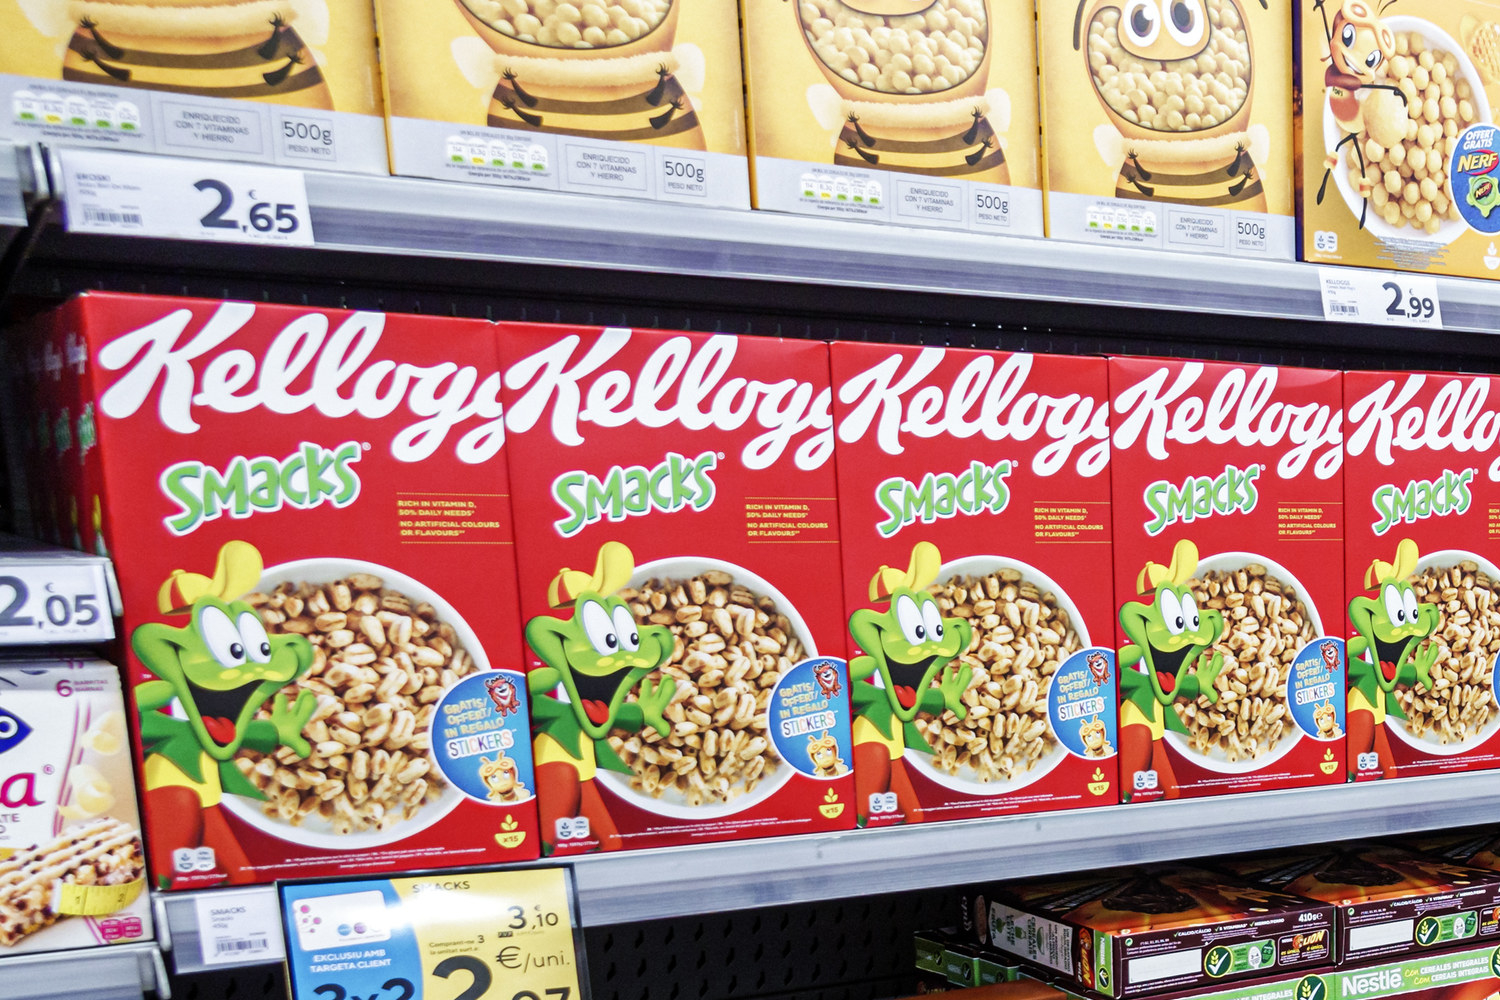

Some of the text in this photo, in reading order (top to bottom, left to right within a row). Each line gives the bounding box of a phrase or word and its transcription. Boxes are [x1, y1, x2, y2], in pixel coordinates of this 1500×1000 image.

[283, 121, 333, 146] 500g
[1463, 138, 1493, 150] GRATIS
[1466, 129, 1496, 140] OFFERT
[665, 160, 705, 183] 500g
[1457, 152, 1500, 173] NERF
[1382, 281, 1435, 319] 2,99
[449, 731, 513, 756] STICKERS
[364, 949, 386, 957] AMB
[310, 959, 390, 973] TARGETA CLIENT
